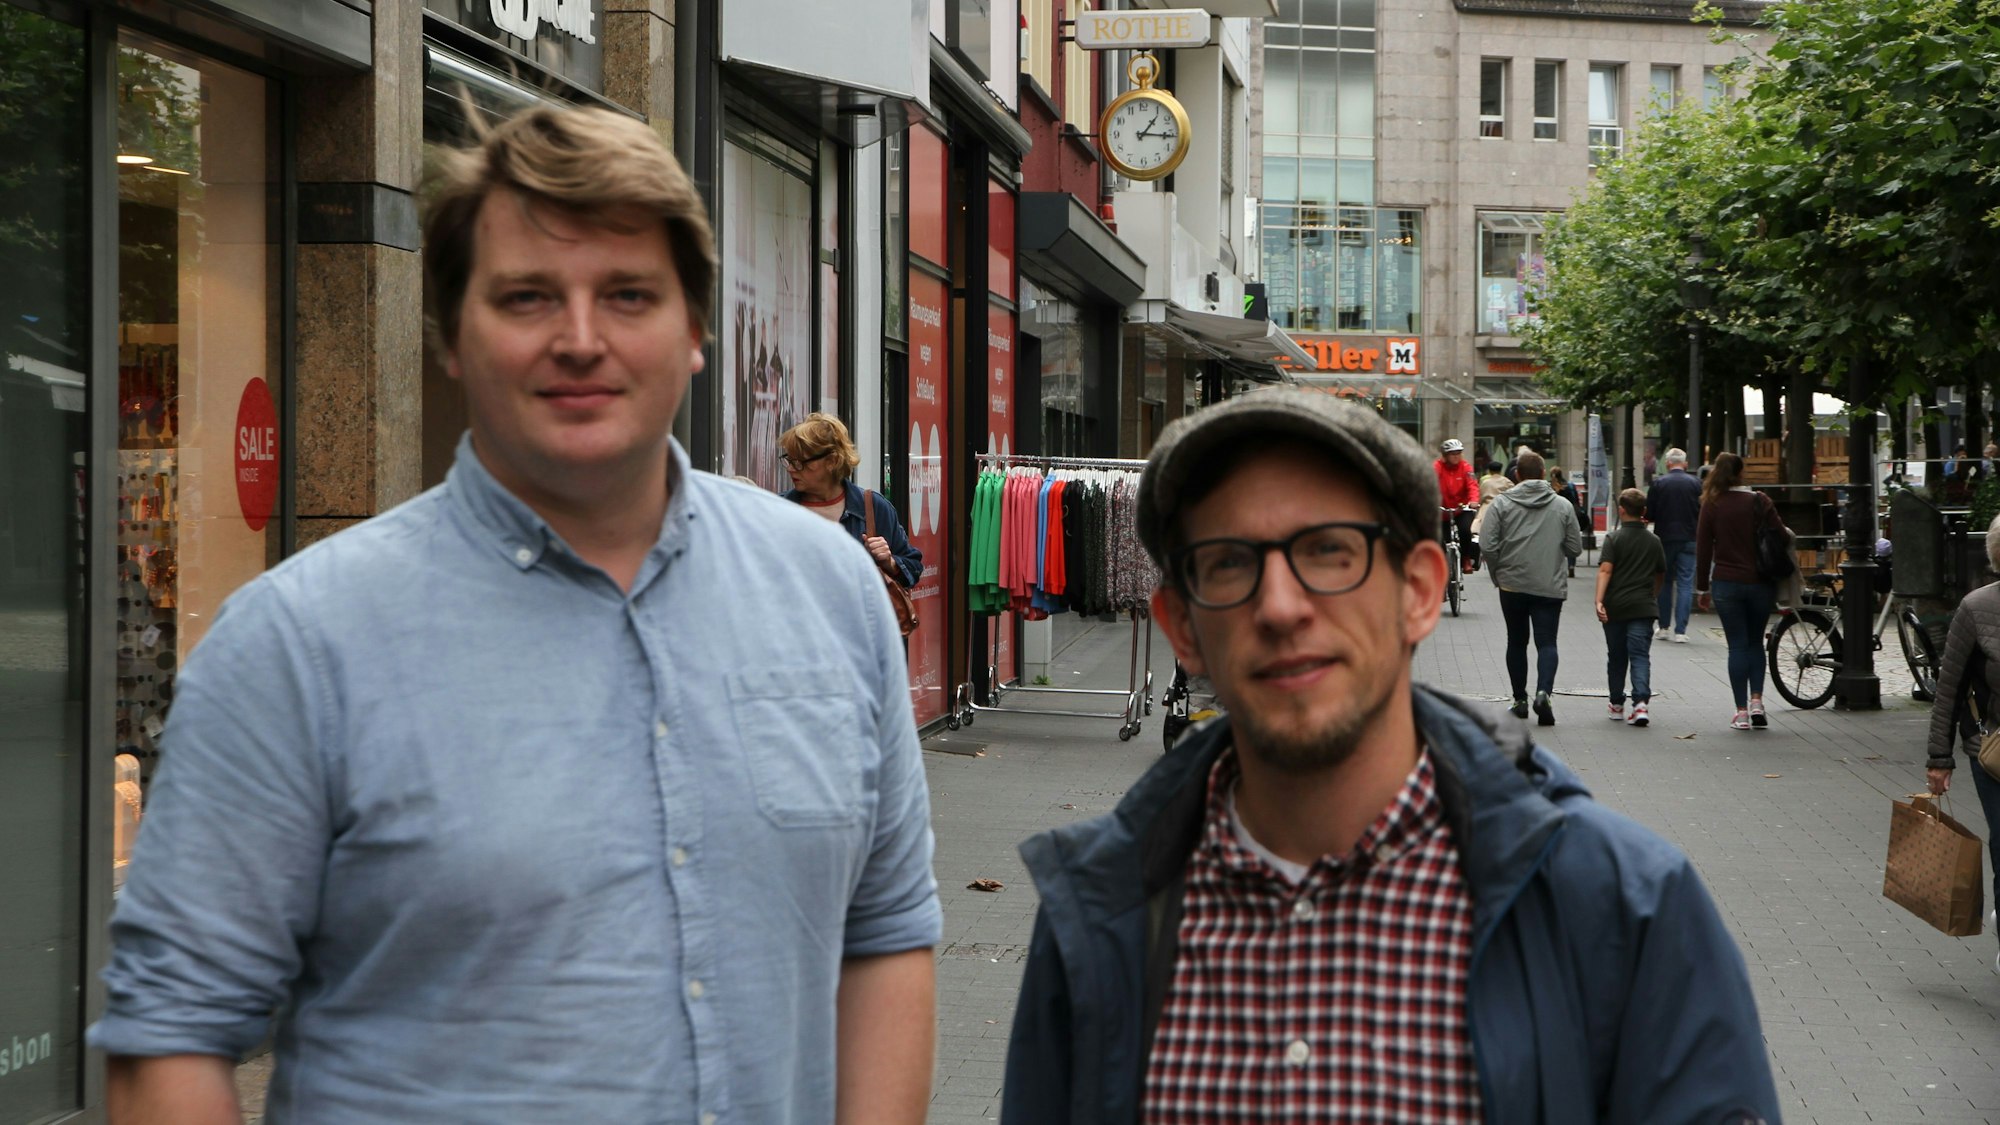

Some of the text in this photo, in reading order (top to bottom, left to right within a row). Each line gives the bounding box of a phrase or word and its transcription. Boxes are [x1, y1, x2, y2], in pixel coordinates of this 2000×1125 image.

[1092, 15, 1192, 40] ROTHE
[1395, 349, 1411, 363] M
[239, 426, 275, 461] SALE
[239, 468, 259, 482] INSIDE
